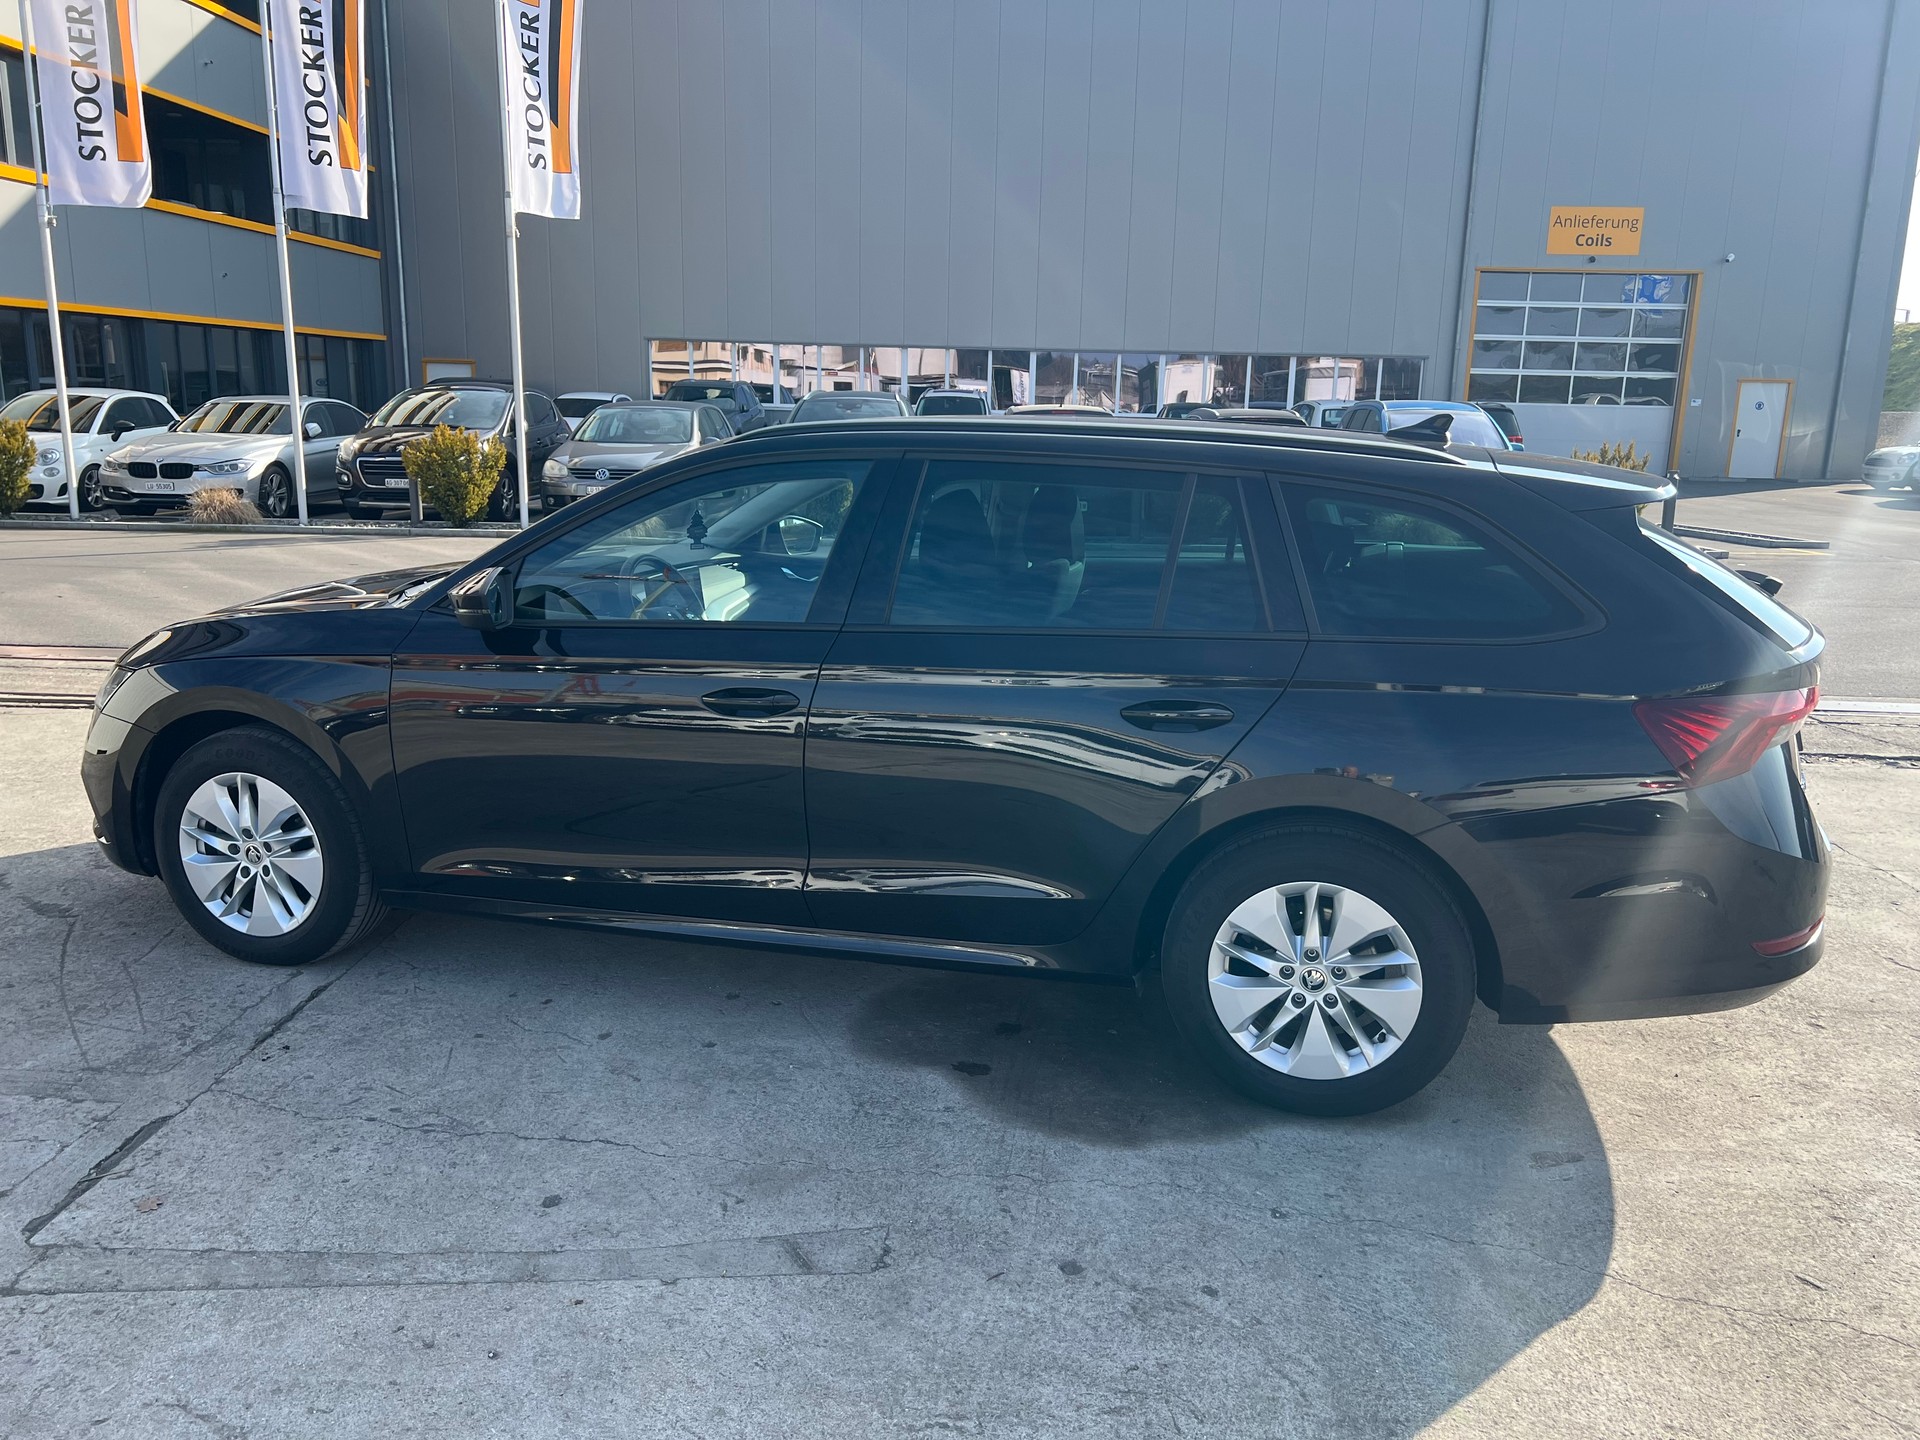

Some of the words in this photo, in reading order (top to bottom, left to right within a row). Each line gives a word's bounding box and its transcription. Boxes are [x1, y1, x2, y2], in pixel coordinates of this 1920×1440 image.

[65, 4, 107, 162] STOCKER
[299, 6, 333, 167] STOCKER
[520, 10, 547, 171] STOCKER
[1552, 215, 1640, 233] Anlieferung
[1575, 233, 1613, 247] Coils
